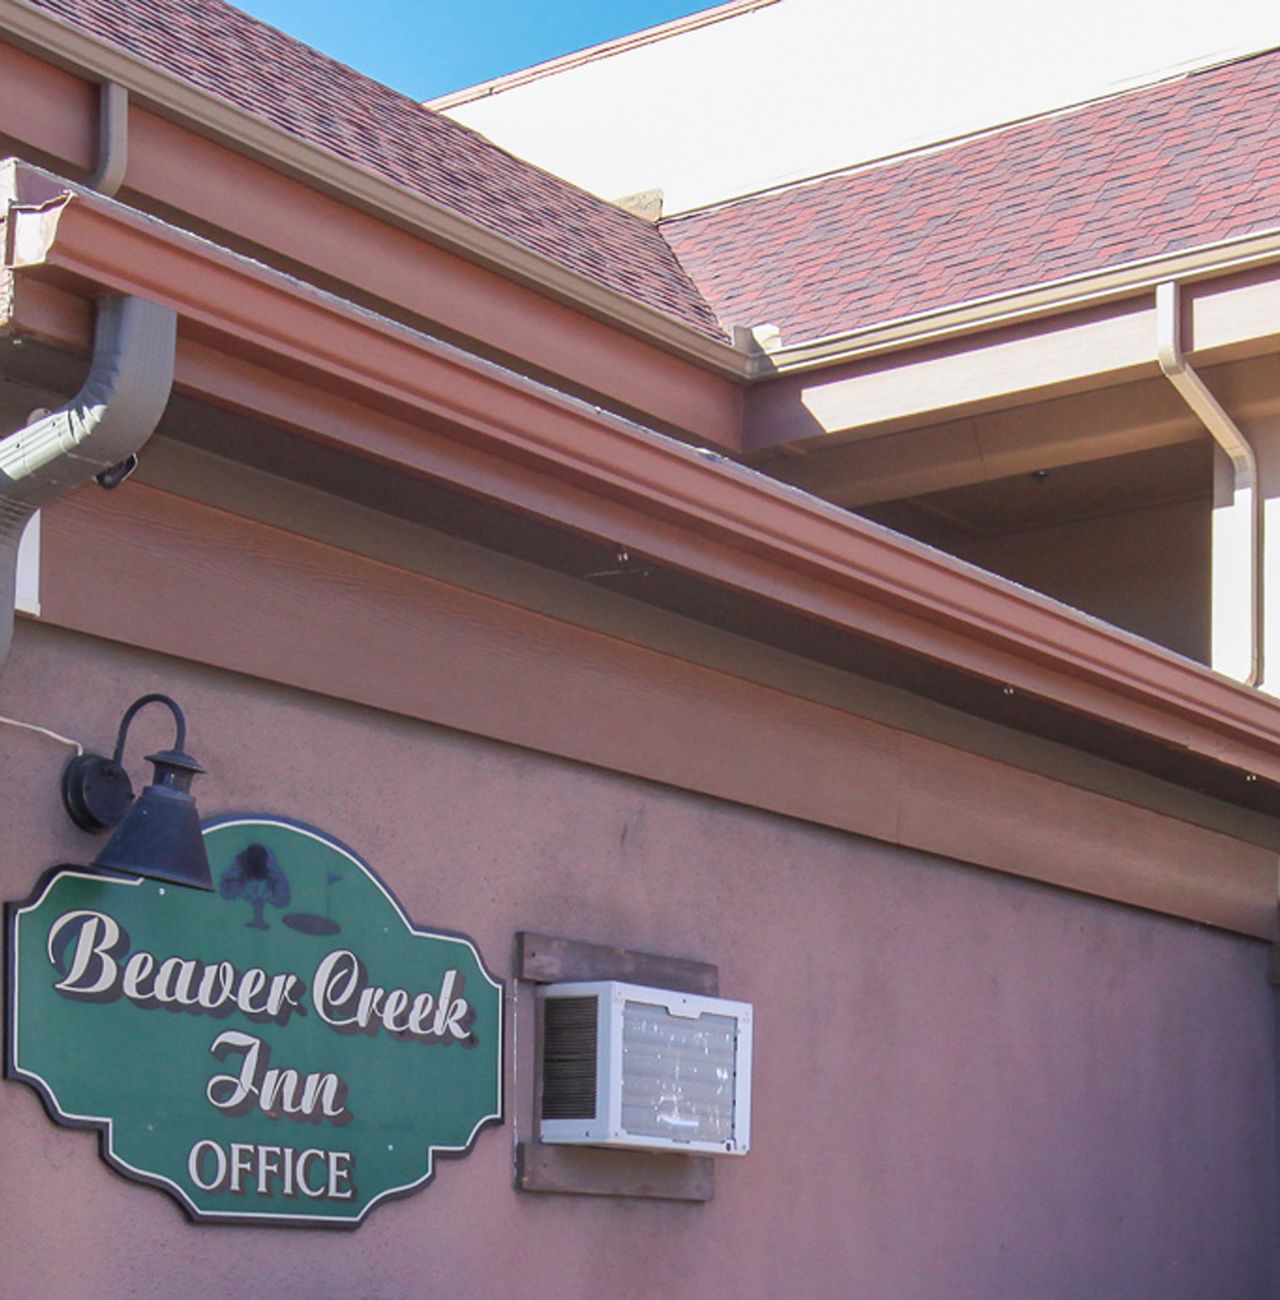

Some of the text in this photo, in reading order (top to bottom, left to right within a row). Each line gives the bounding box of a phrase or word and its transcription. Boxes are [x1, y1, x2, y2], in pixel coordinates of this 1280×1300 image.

[46, 909, 473, 1040] Beaver Creek
[205, 1029, 347, 1118] Inn
[187, 1138, 354, 1199] OFFICE
